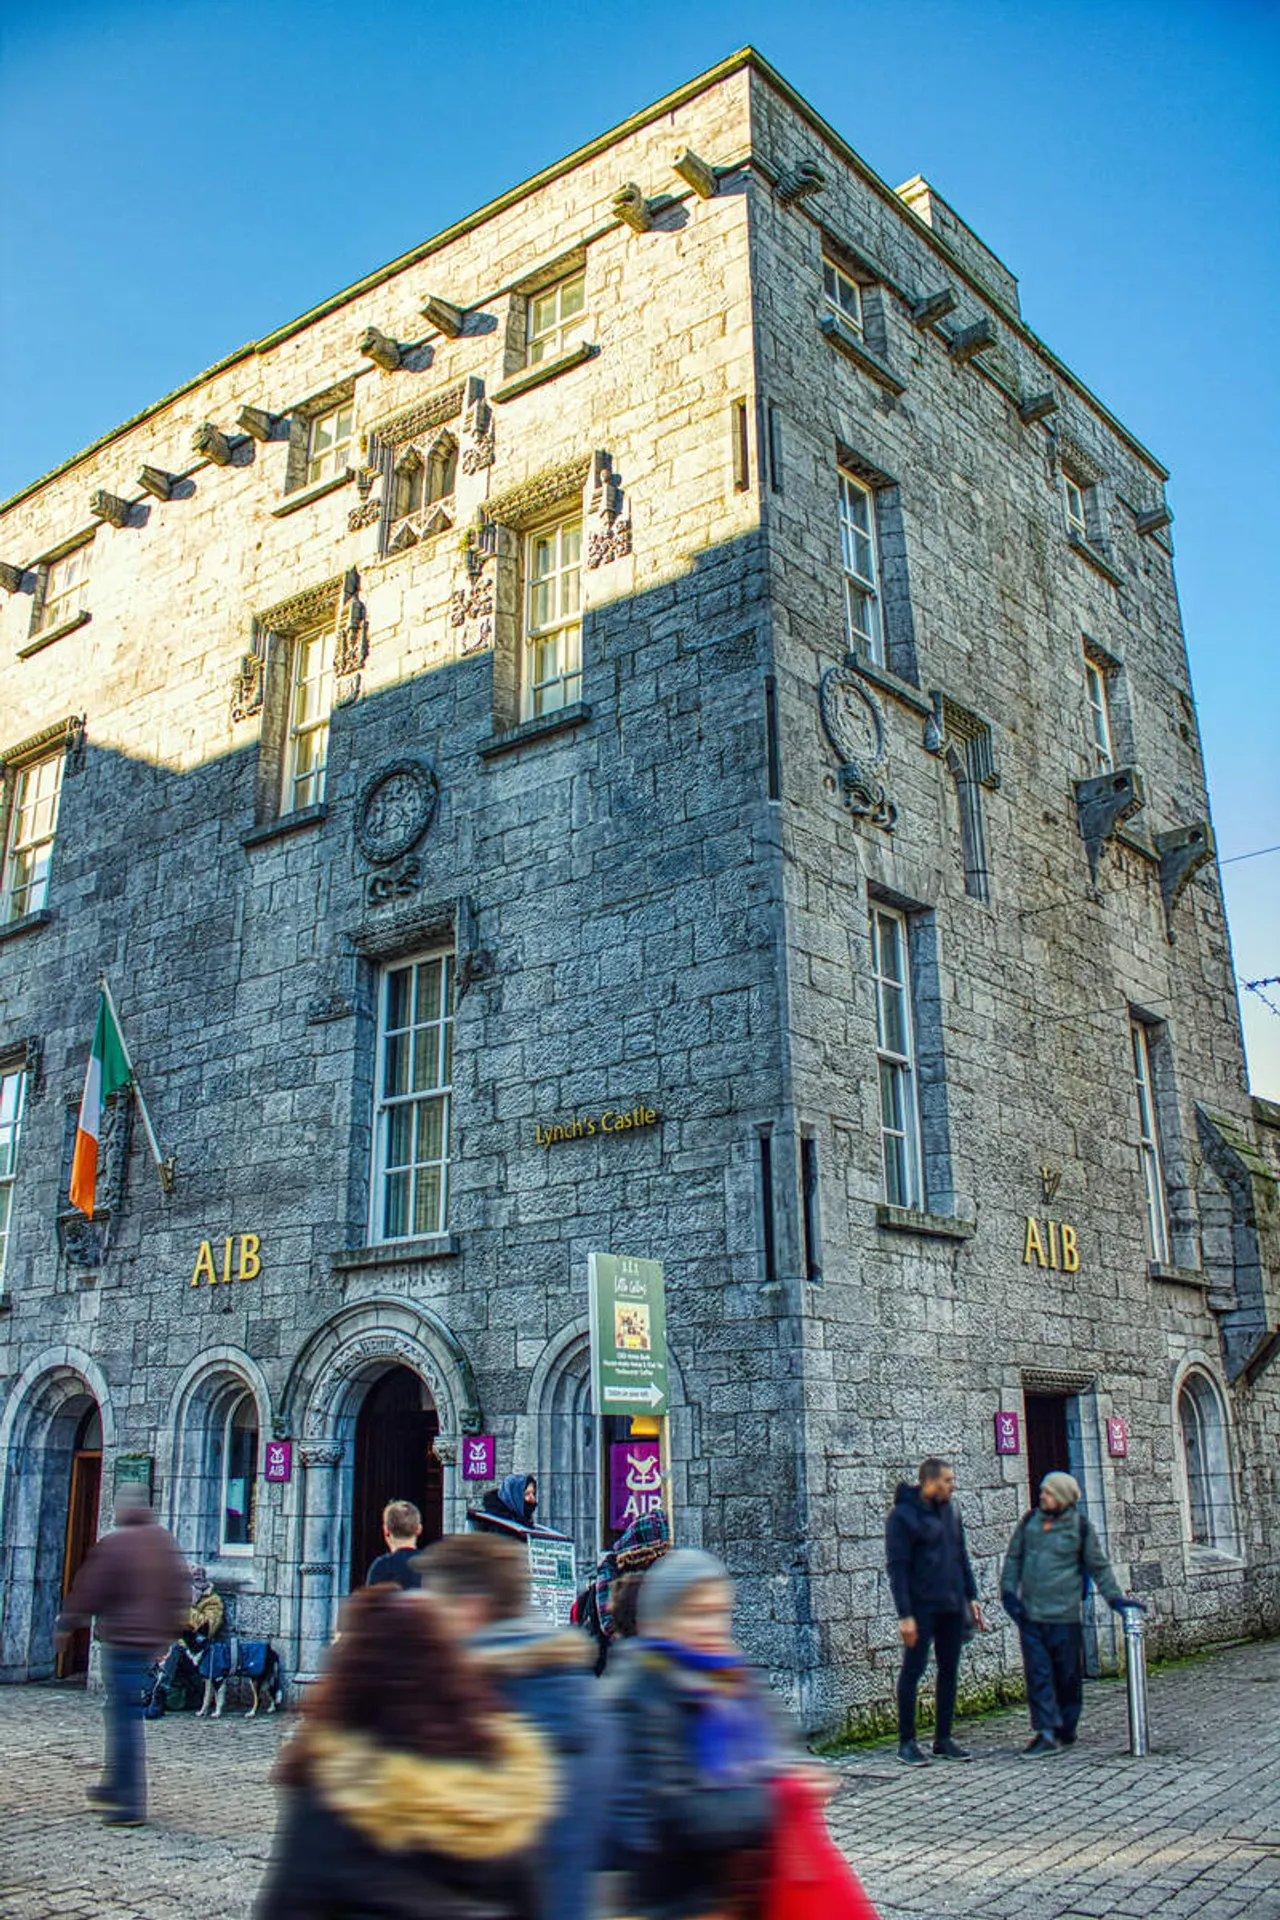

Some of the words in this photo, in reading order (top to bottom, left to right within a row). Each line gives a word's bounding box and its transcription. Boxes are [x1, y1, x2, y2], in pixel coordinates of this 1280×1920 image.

[536, 1115, 595, 1150] Lynch's
[601, 1105, 656, 1131] Castle
[1023, 1216, 1080, 1271] AIB
[190, 1233, 262, 1287] AIB
[1001, 1437, 1015, 1449] AIB
[1112, 1441, 1124, 1451] AIB
[269, 1465, 285, 1476] AIB
[468, 1462, 488, 1474] AIB
